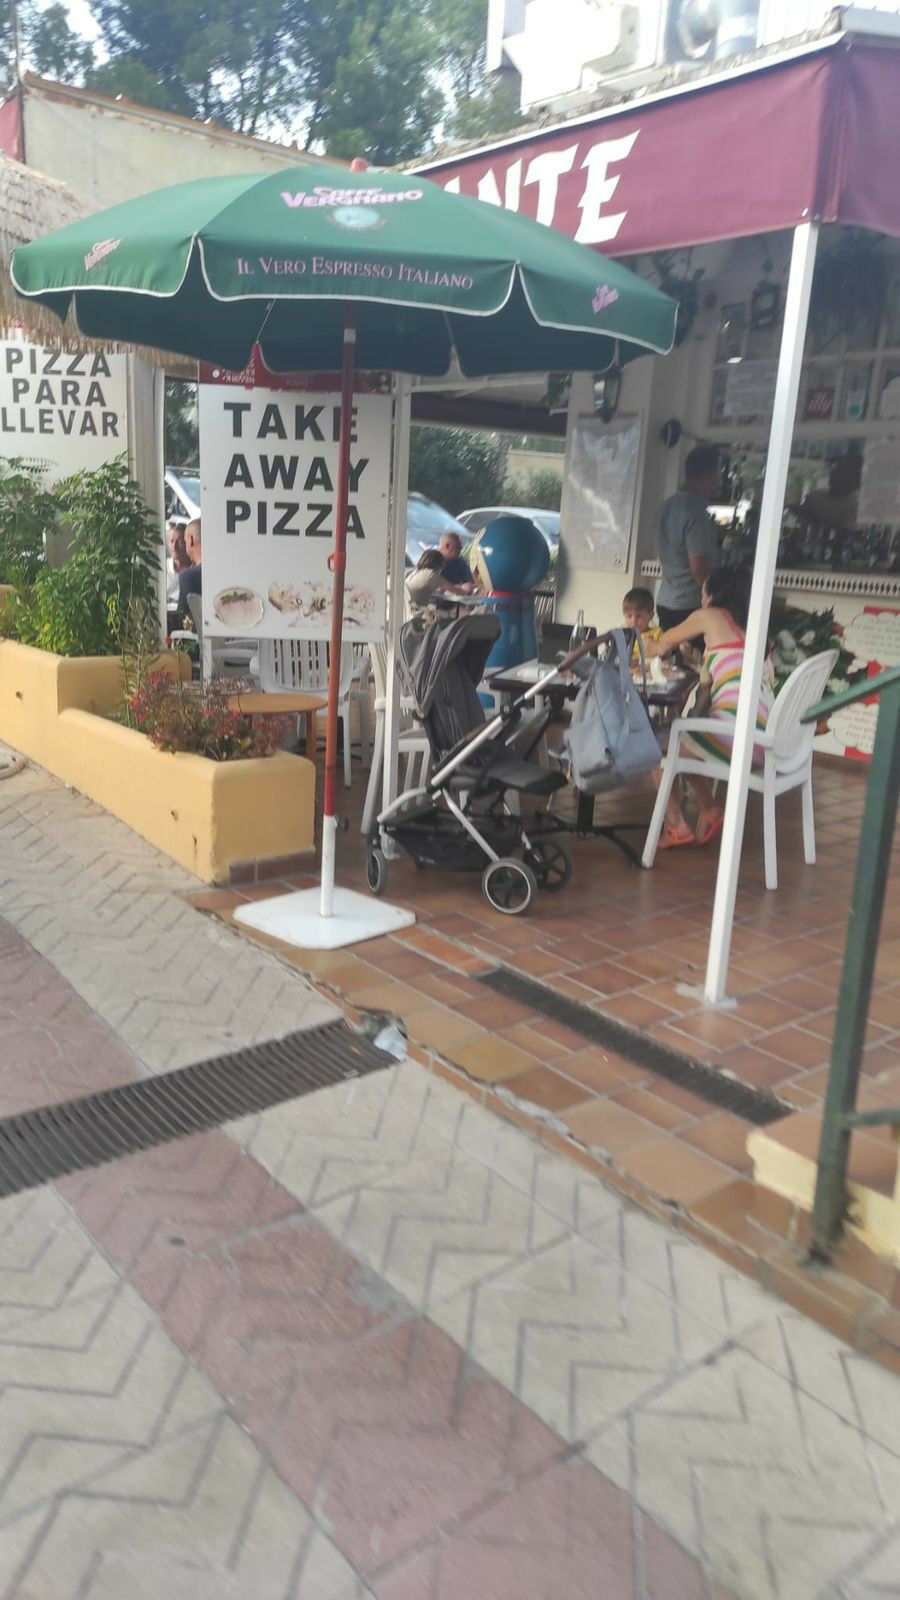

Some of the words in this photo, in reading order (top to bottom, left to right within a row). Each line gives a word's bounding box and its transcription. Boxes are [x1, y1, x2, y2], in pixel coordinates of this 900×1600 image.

[444, 128, 641, 245] NTE
[6, 347, 112, 378] PIZZA
[12, 378, 107, 407] PARA
[1, 407, 120, 438] LLEVAR
[223, 402, 358, 443] TAKE
[223, 453, 370, 493] AWAY
[226, 500, 366, 539] PIZZA
